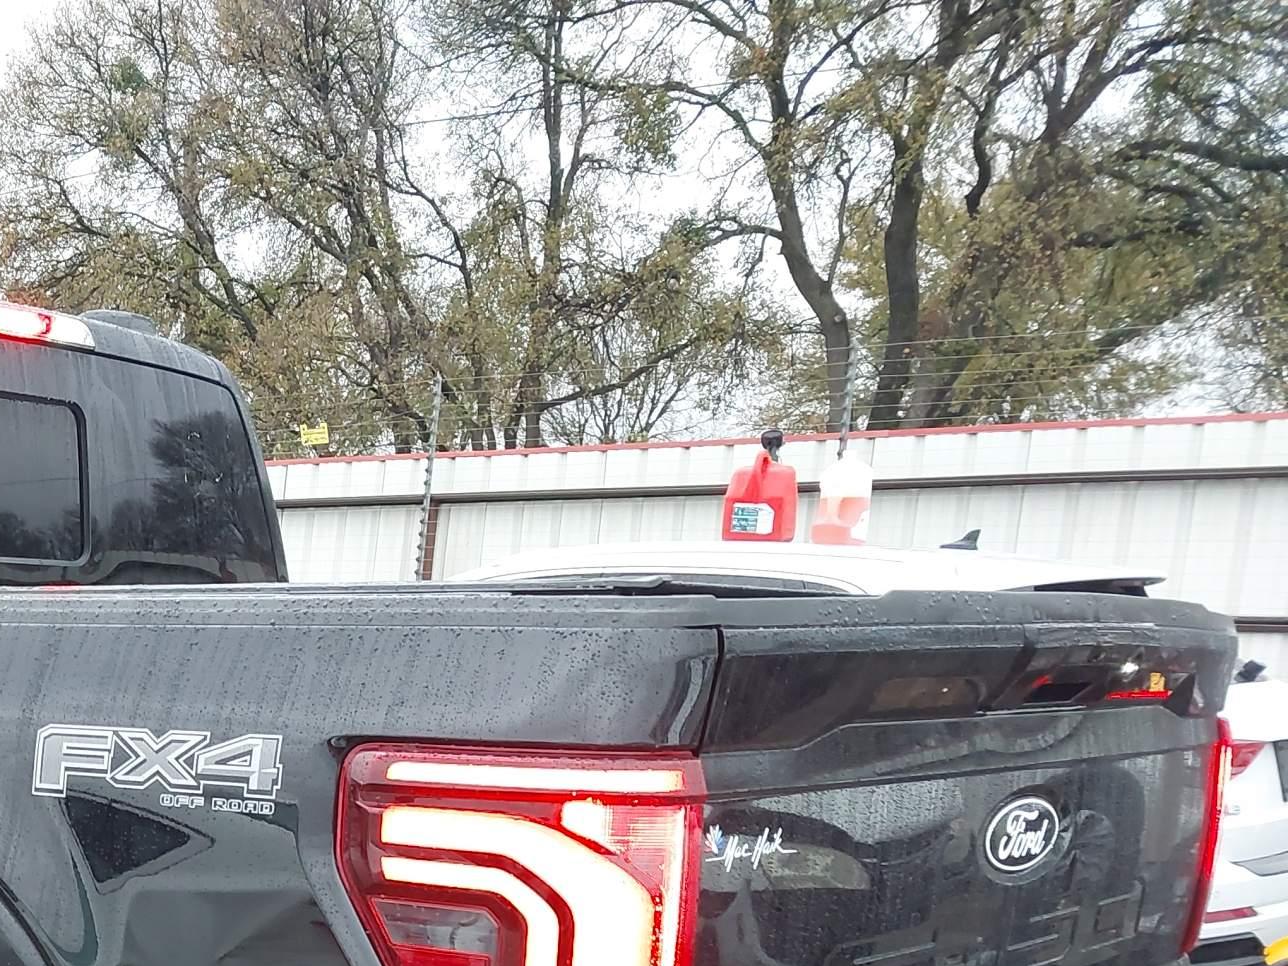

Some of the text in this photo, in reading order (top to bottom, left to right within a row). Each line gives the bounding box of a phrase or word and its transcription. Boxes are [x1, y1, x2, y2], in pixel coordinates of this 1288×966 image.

[32, 723, 283, 799] FX4
[159, 794, 276, 815] OFF ROAD
[998, 810, 1049, 860] Ford
